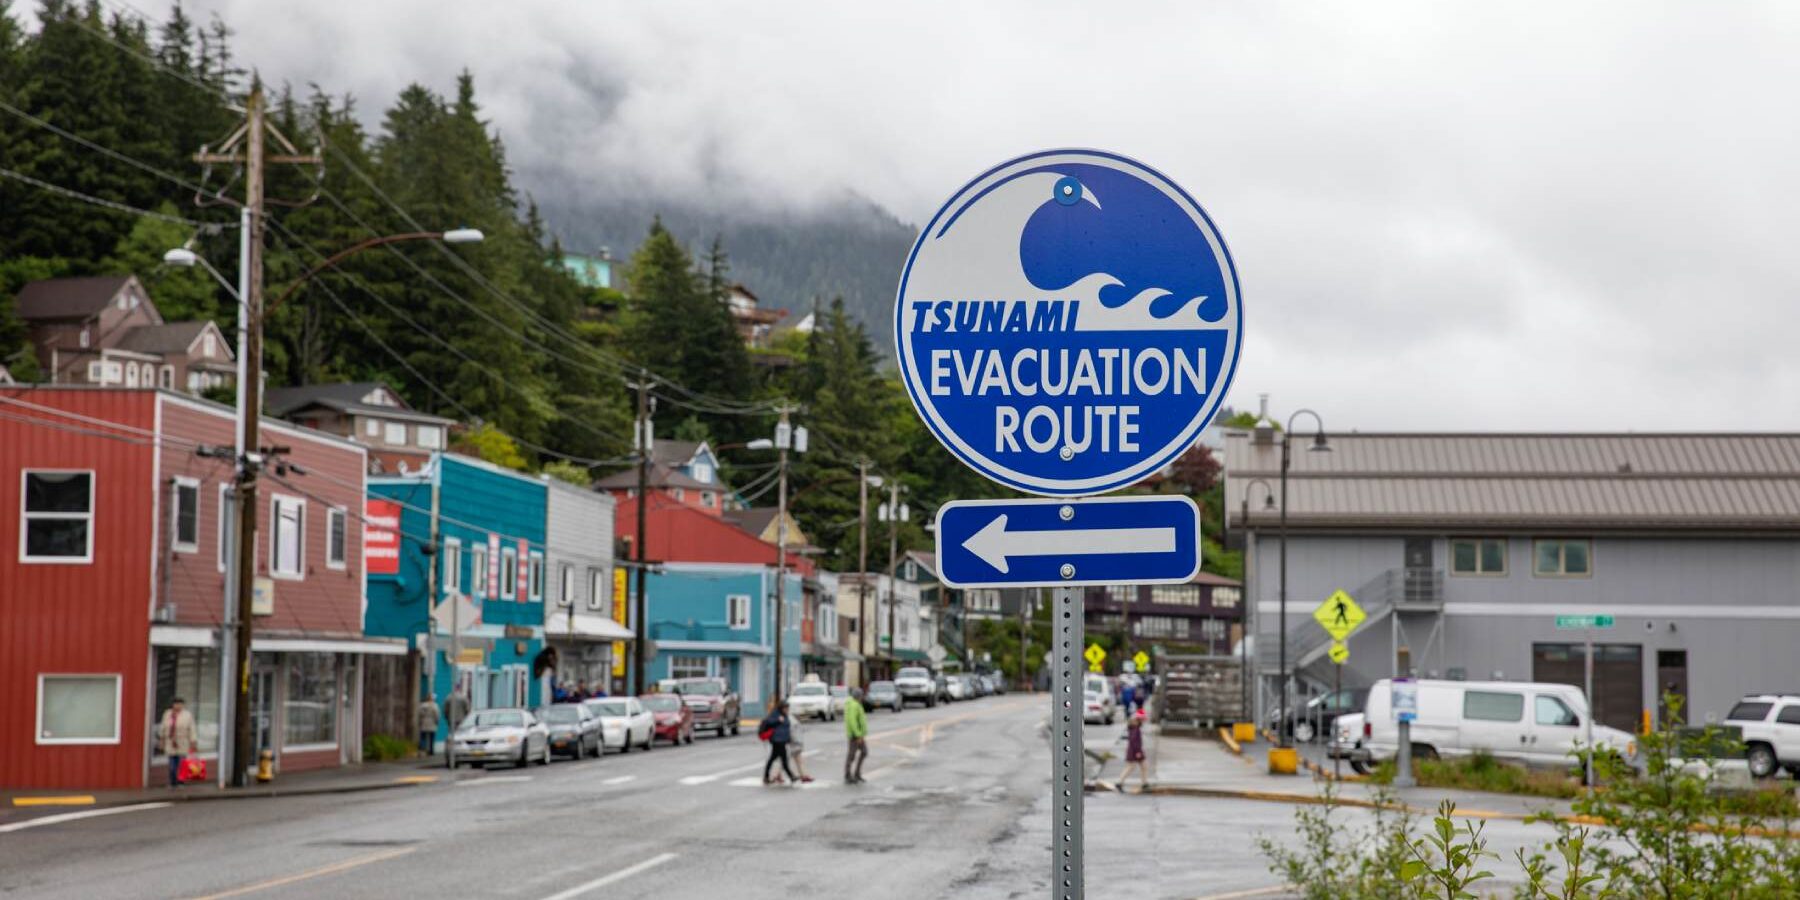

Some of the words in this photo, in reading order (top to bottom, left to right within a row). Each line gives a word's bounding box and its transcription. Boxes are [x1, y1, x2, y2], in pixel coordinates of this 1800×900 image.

[912, 301, 1080, 332] TSUNAMI
[932, 348, 1206, 396] EVACUATION
[997, 406, 1139, 453] ROUTE
